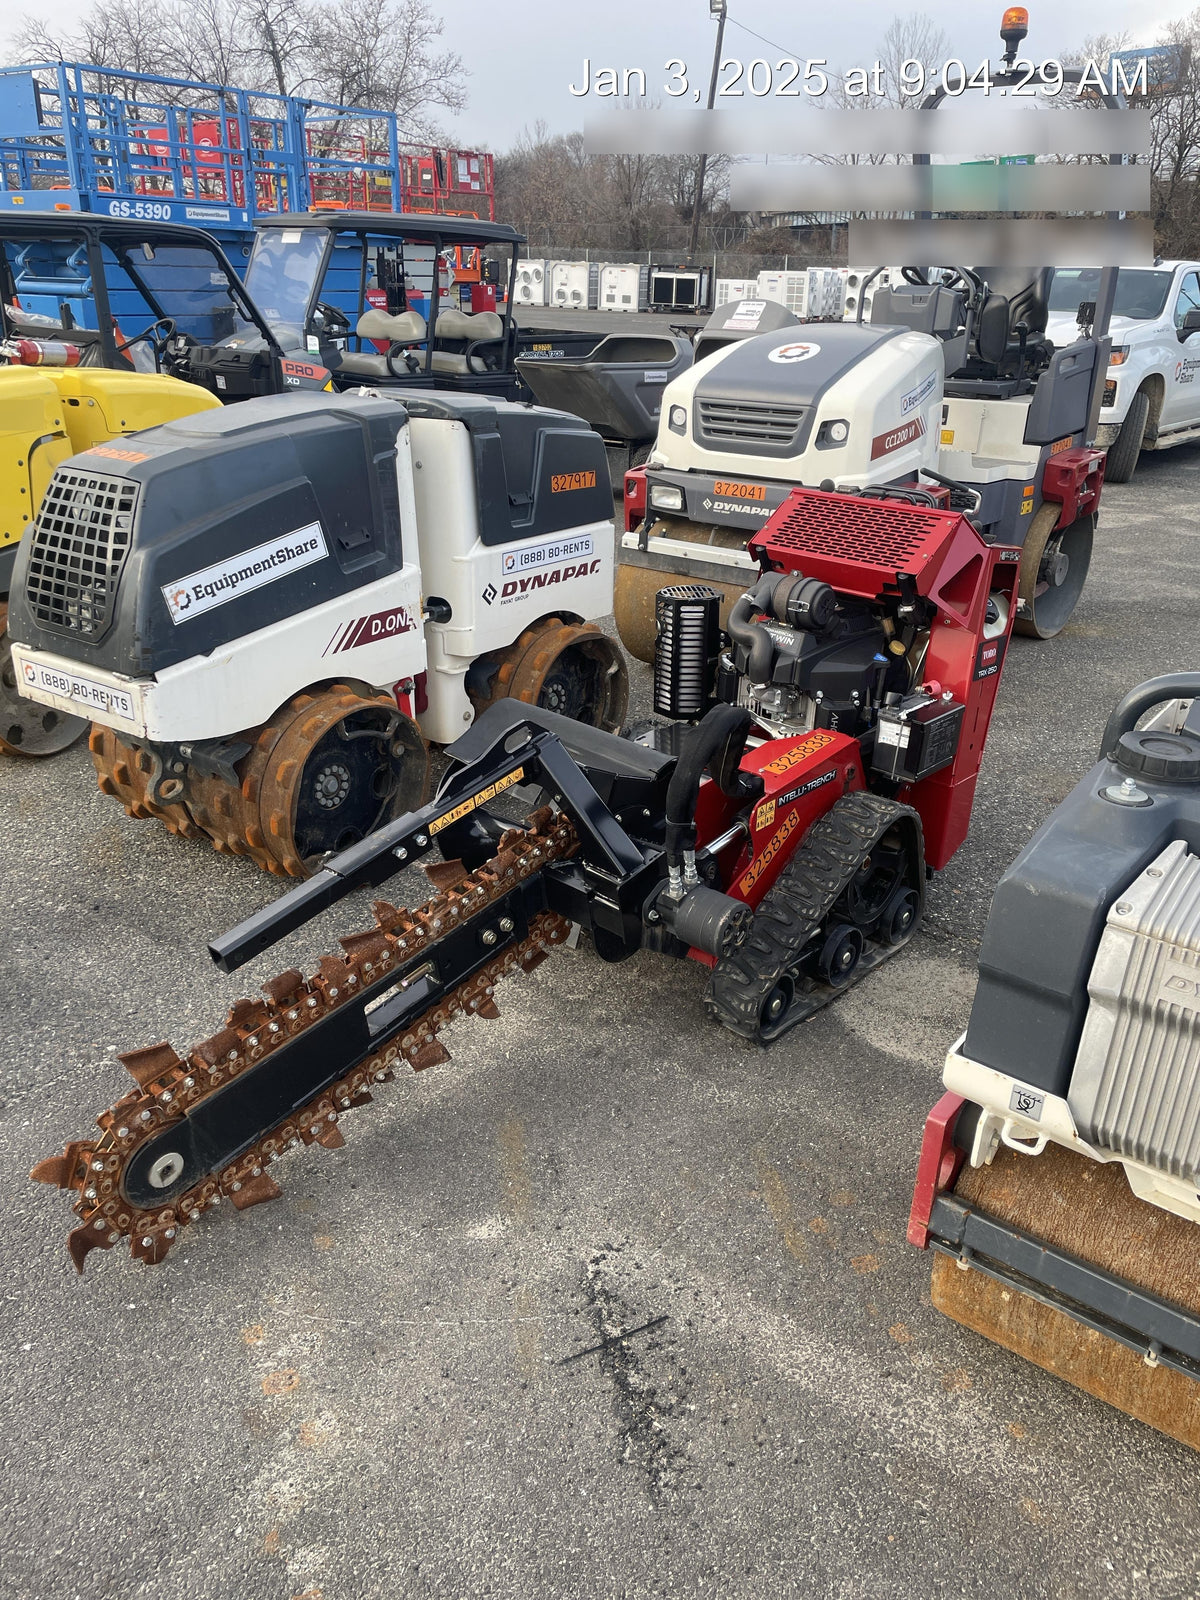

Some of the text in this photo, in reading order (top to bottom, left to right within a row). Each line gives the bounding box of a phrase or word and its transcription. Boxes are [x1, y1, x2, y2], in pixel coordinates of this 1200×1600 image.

[109, 200, 171, 220] GS-5390
[285, 363, 314, 376] PRO
[287, 377, 300, 385] XD
[885, 428, 908, 449] CC1200
[552, 471, 595, 492] 327917
[715, 481, 763, 499] 372041
[520, 549, 545, 566] (888)
[191, 538, 319, 601] EquipmentShare
[501, 559, 601, 598] DYNAPAC
[770, 633, 795, 646] TWIN
[983, 647, 997, 660] TORO
[41, 671, 70, 693] (888)
[769, 733, 832, 771] 325838
[778, 770, 836, 807] INTELLI-TRENCH
[744, 811, 799, 888] 325838
